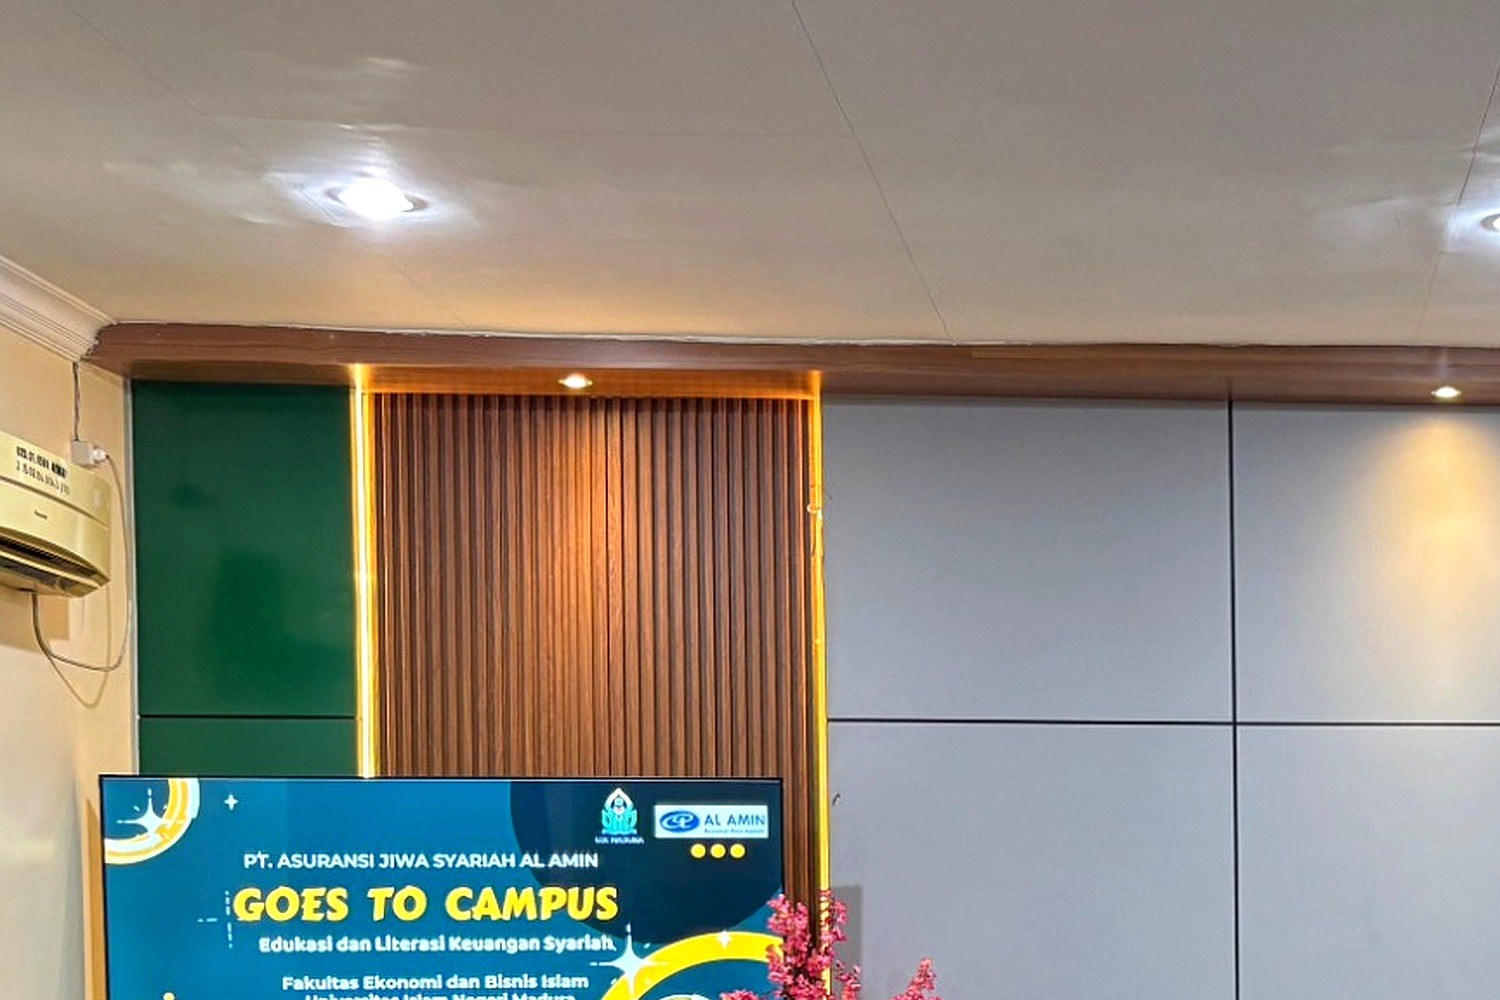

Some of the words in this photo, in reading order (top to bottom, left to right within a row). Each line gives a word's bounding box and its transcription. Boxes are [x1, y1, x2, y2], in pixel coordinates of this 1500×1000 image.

[704, 814, 721, 826] AL
[727, 814, 766, 826] AMIN
[244, 852, 273, 869] PT.
[277, 853, 374, 869] ASURANSI
[379, 853, 430, 869] JIWA
[433, 853, 516, 869] SYARIAH
[520, 853, 545, 869] AL
[548, 852, 599, 869] AMIN
[233, 885, 349, 922] GOES
[367, 885, 427, 922] TO
[445, 886, 619, 922] CAMPUS
[258, 935, 333, 953] Edukasi
[336, 936, 372, 952] dan
[375, 934, 446, 952] Literasi
[449, 936, 540, 954] Keuangan
[544, 934, 614, 954] Syariah
[282, 975, 359, 990] Fakultas
[363, 974, 443, 990] Ekonomi
[446, 974, 480, 989] dan
[484, 973, 539, 989] Bisnis
[541, 974, 589, 989] Islam
